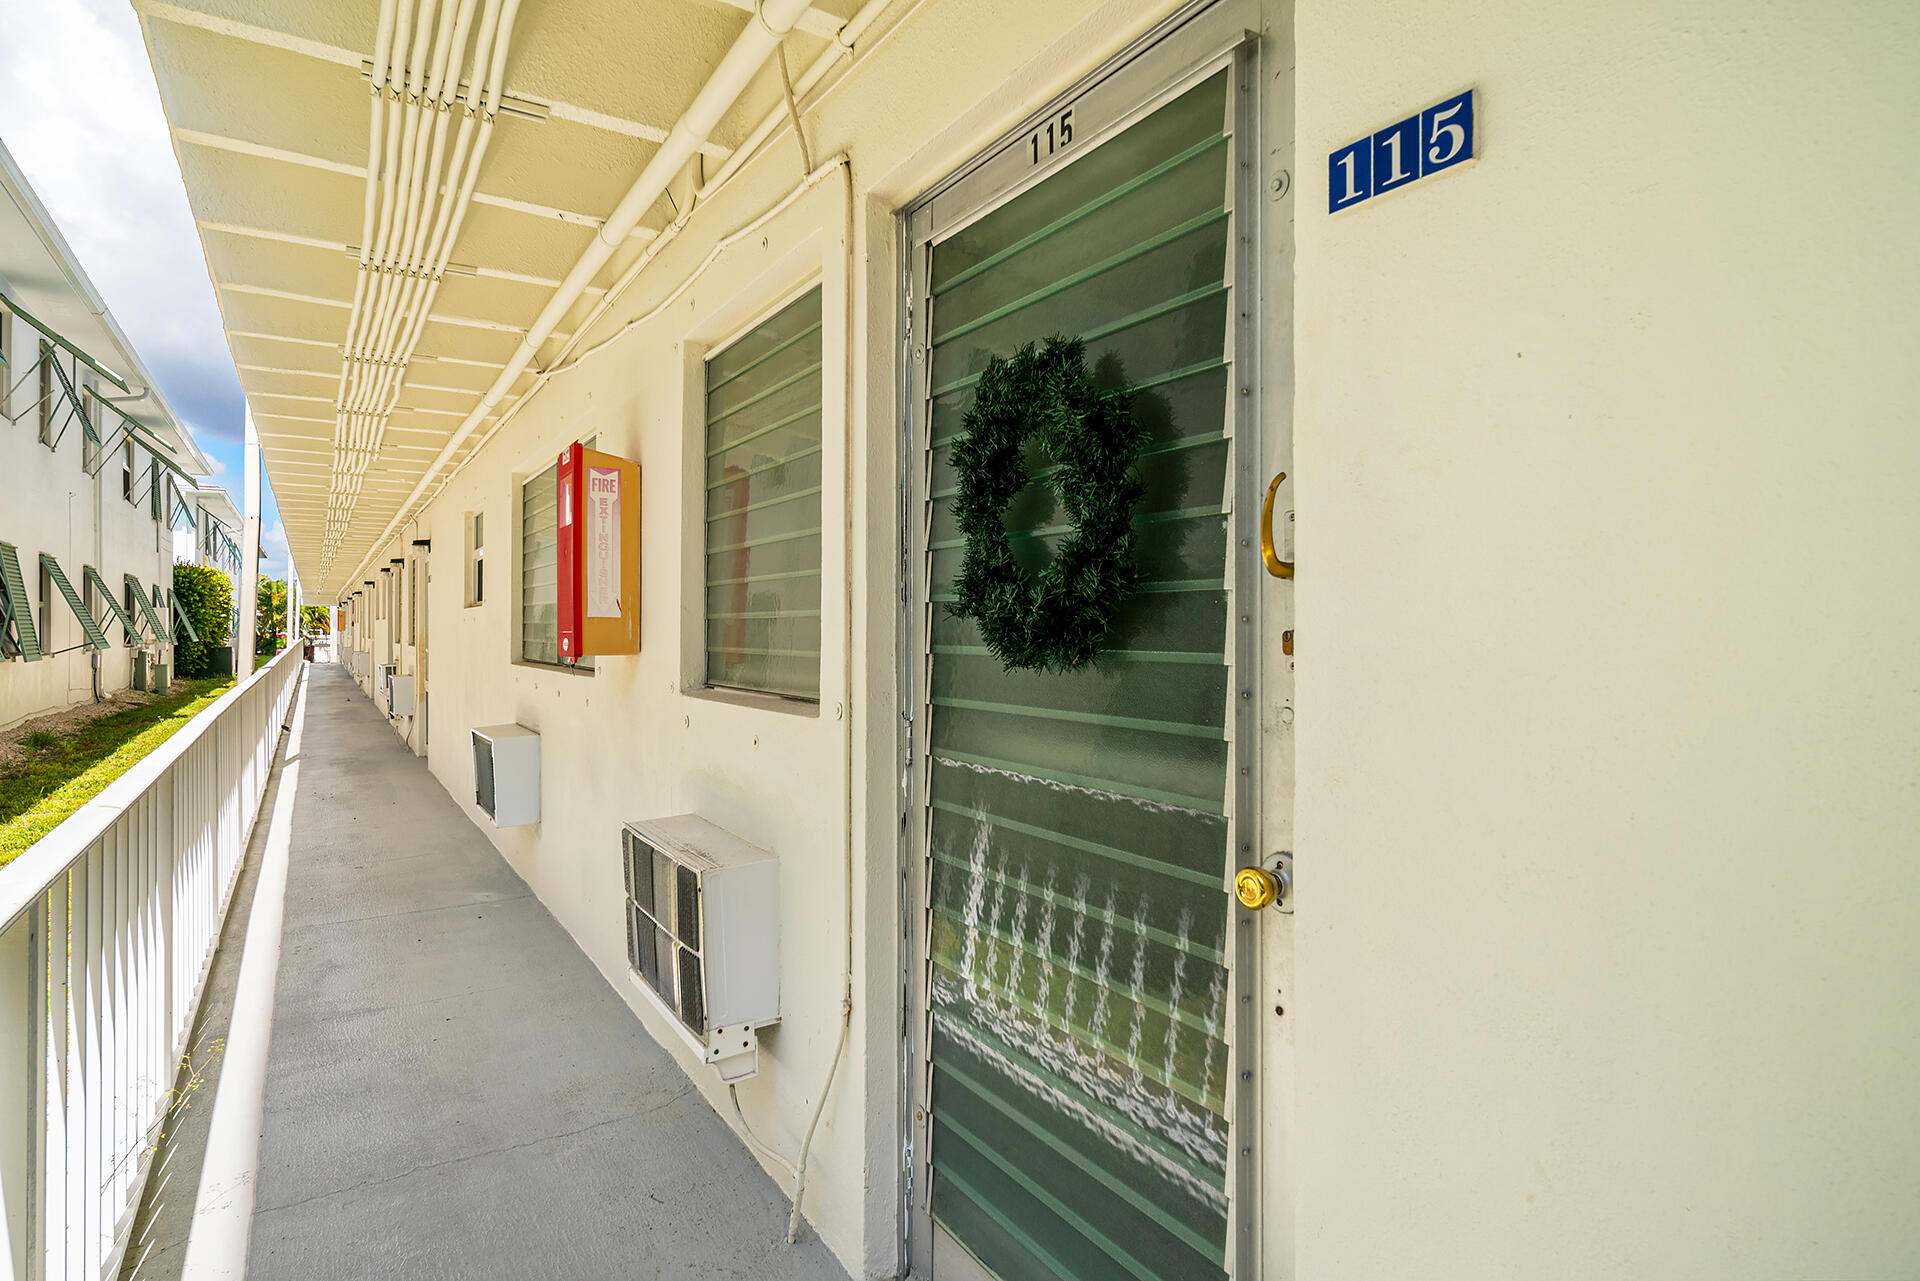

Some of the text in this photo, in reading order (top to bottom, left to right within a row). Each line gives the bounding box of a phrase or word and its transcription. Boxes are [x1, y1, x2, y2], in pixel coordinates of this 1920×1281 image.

[1031, 109, 1073, 165] 115
[1337, 101, 1465, 204] 115
[591, 477, 617, 494] FIRE
